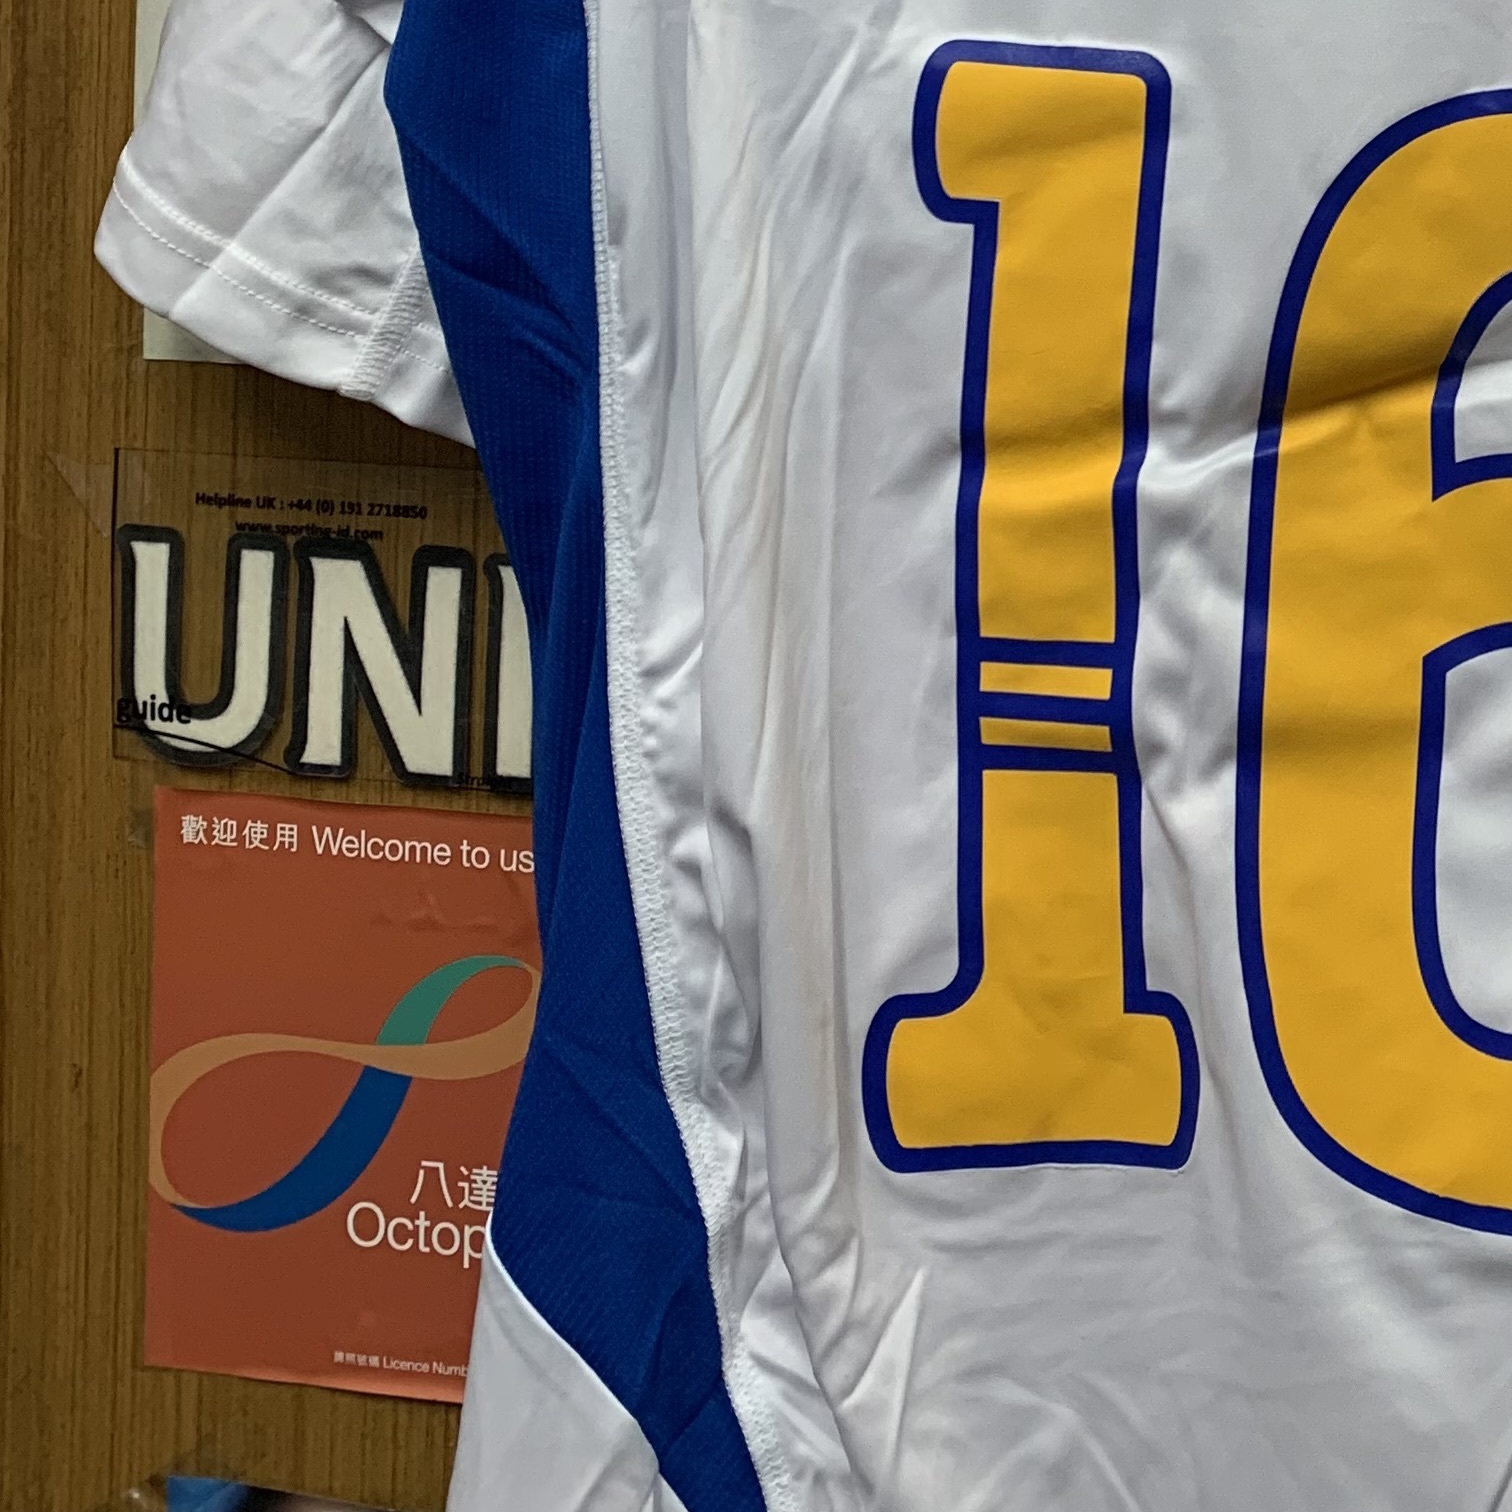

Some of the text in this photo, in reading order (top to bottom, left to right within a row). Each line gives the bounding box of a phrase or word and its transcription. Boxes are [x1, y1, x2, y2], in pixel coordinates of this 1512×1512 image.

[195, 492, 252, 509] Helpline
[256, 495, 276, 510] UK
[316, 497, 335, 516] (0)
[340, 500, 362, 516] 191
[180, 814, 299, 852] 歡迎使用
[311, 825, 451, 866] Welcome
[460, 839, 490, 870] to
[410, 1160, 498, 1212] 八達
[346, 1201, 486, 1268] Octop
[383, 1356, 429, 1373] Licence
